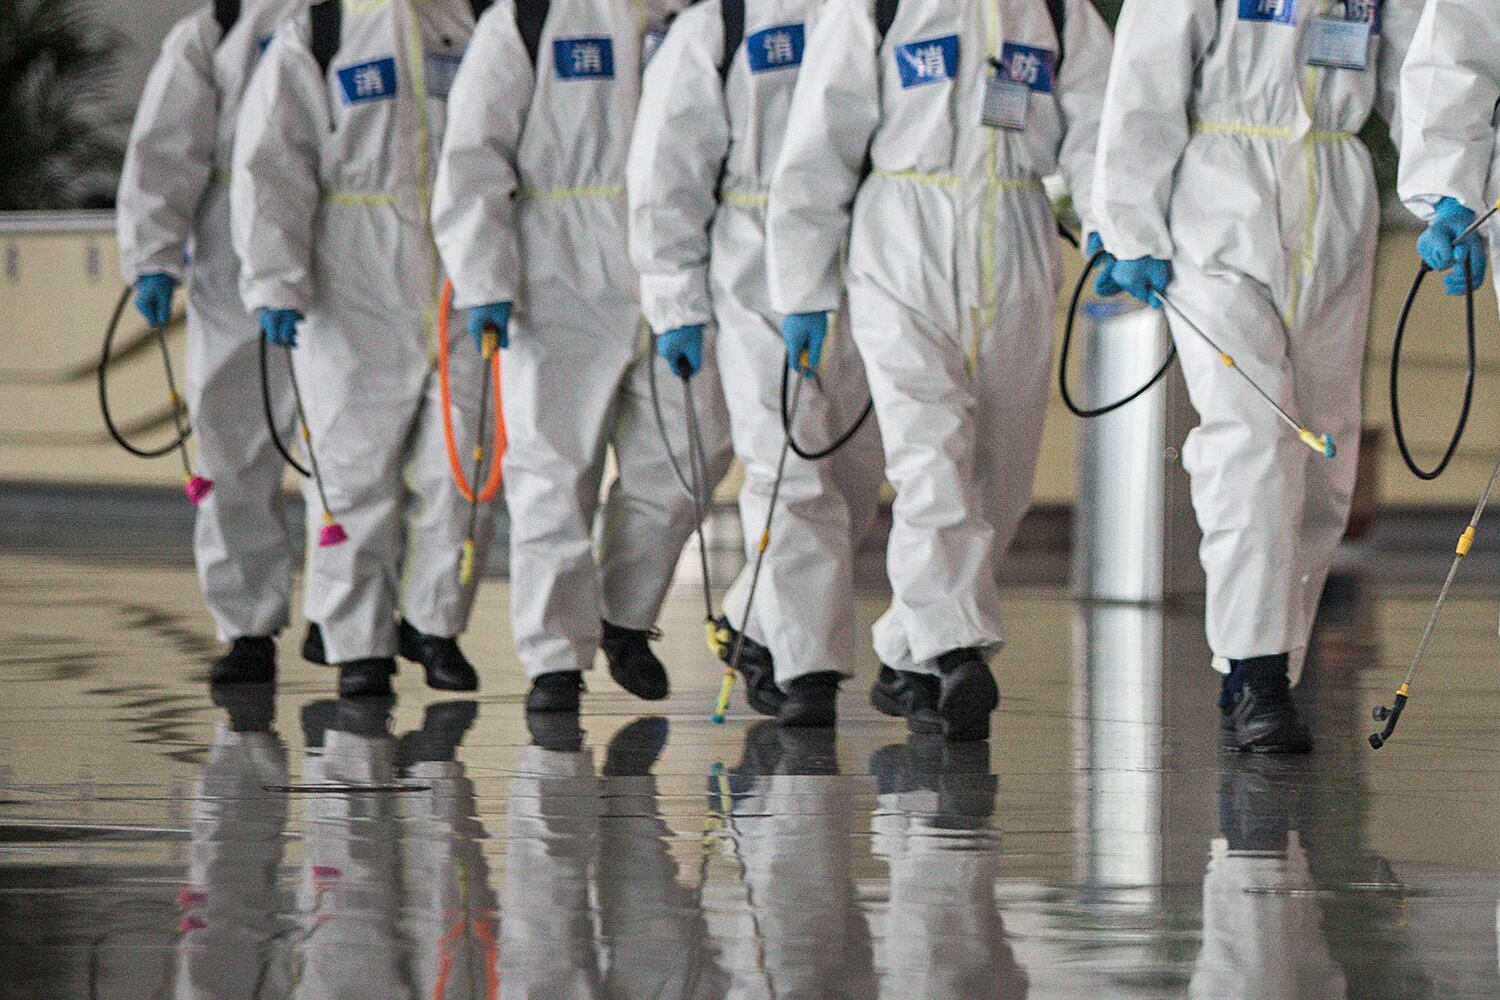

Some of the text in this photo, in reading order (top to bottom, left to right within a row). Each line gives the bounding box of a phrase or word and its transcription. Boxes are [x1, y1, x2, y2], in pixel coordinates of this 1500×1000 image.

[571, 45, 600, 73] 消
[914, 44, 948, 78] 消
[354, 67, 384, 96] 消
